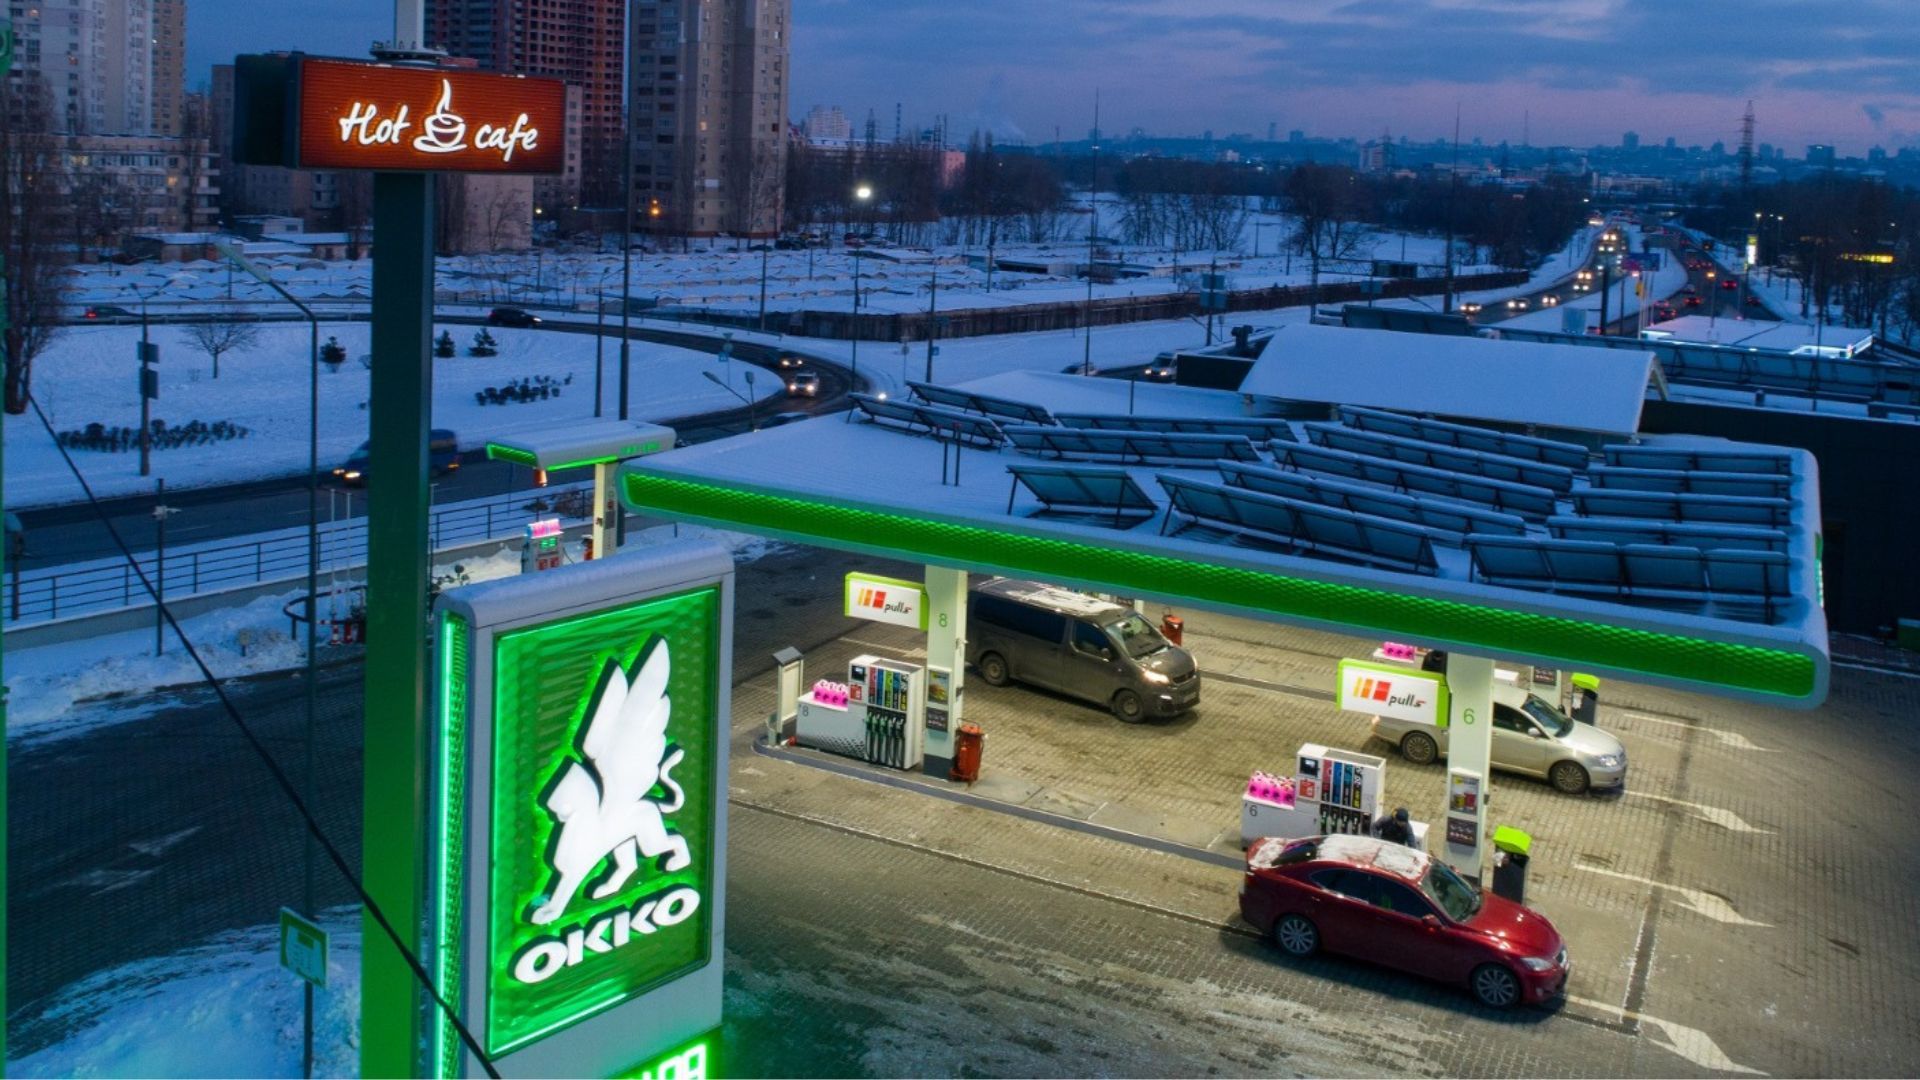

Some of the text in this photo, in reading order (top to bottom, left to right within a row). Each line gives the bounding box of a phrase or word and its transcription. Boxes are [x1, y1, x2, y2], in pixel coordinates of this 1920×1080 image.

[339, 102, 538, 162] Hot cafe
[884, 602, 912, 613] pulls
[939, 613, 948, 627] 8
[1388, 694, 1426, 708] pulls
[1463, 708, 1475, 725] 6
[1249, 805, 1258, 816] 6
[514, 888, 700, 984] OKKO
